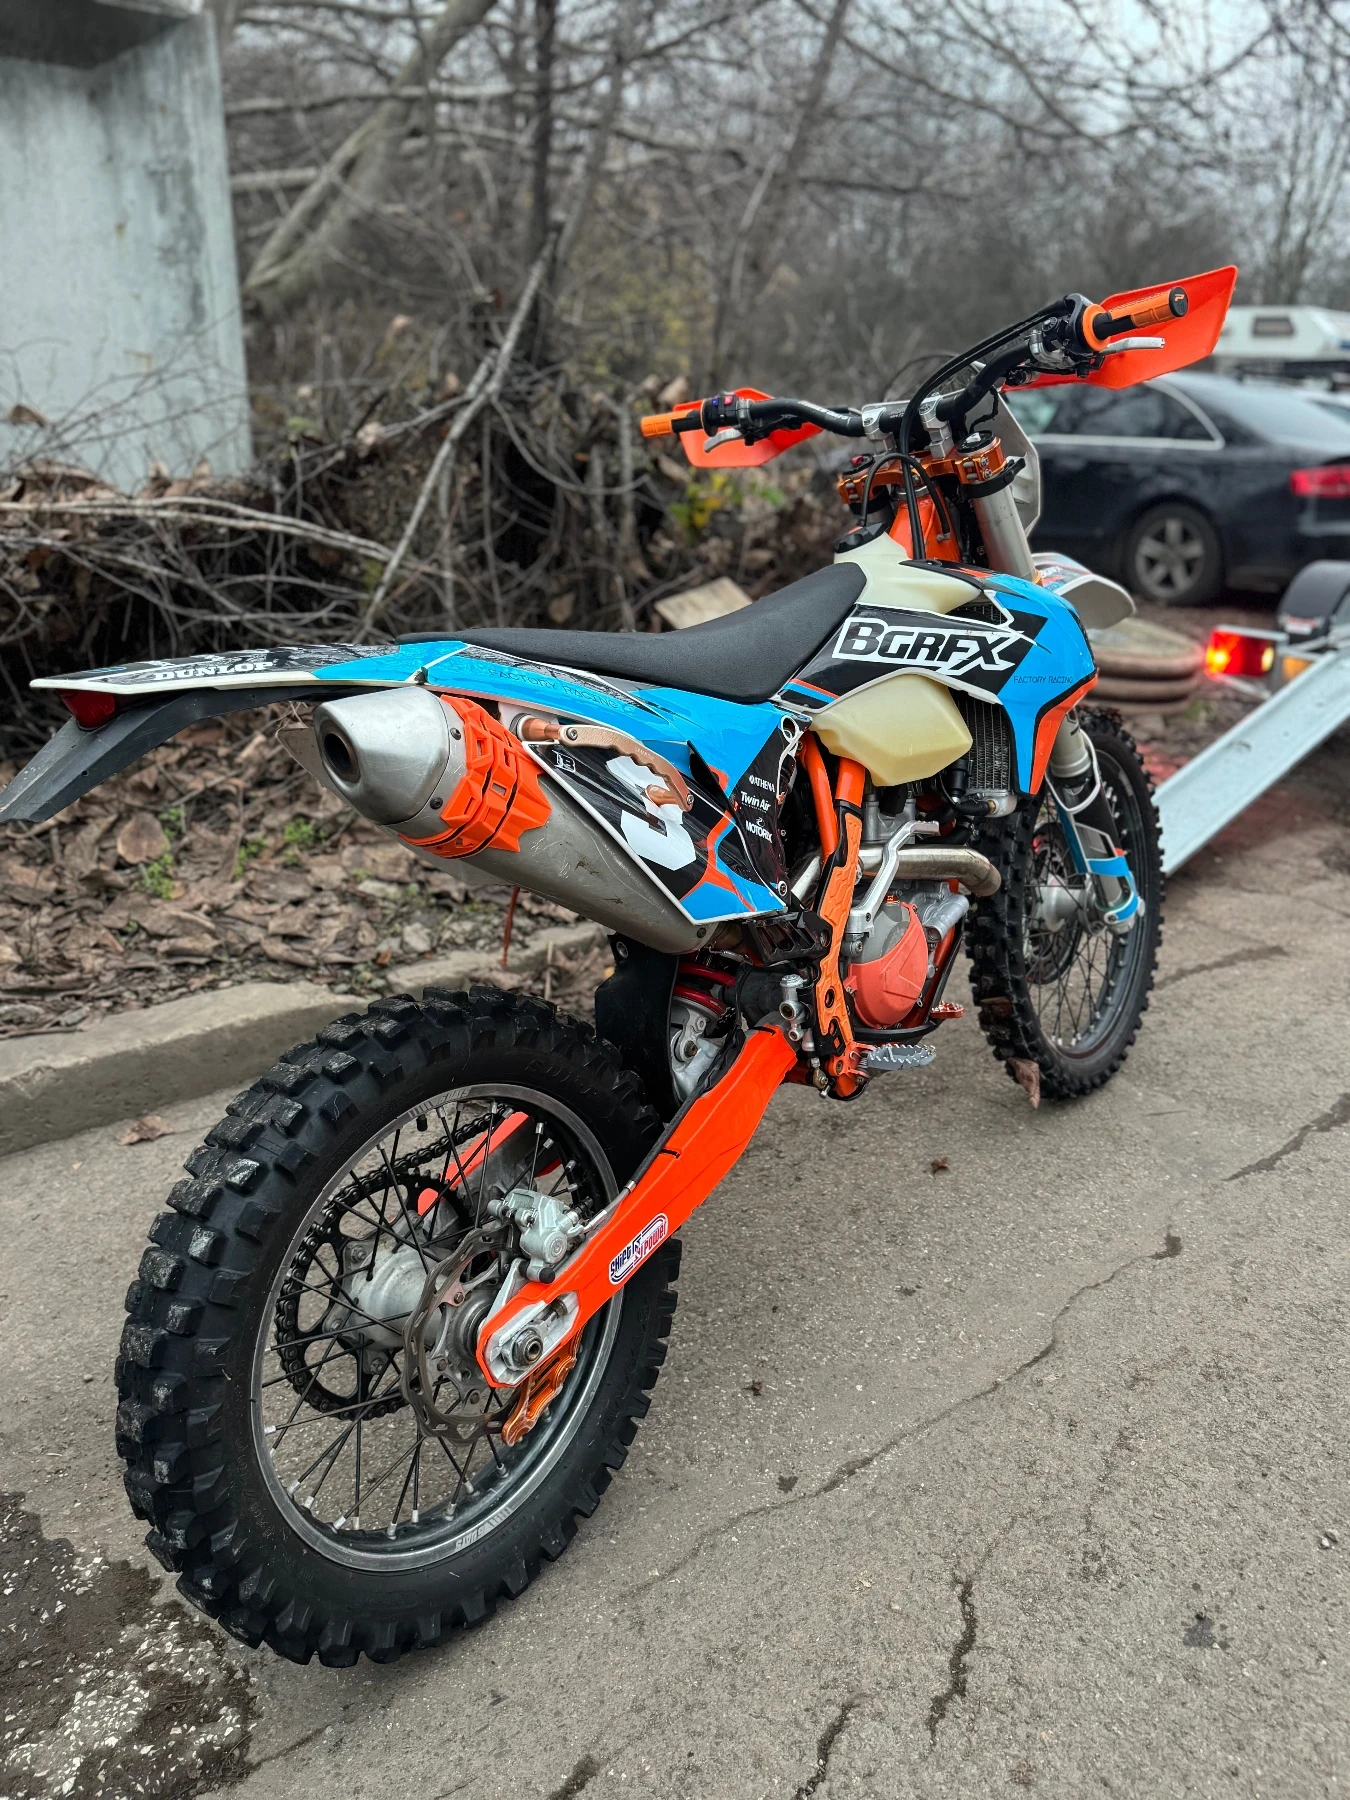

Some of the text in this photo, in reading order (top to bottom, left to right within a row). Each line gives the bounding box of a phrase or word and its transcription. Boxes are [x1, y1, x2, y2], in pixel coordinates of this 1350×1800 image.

[833, 617, 1014, 676] BGRFX
[153, 661, 274, 681] DUNLOP
[1013, 675, 1073, 684] FACTORY RACING
[489, 667, 618, 709] FACTORY RACING
[753, 777, 776, 793] ATHENA
[740, 791, 760, 807] Twin
[760, 799, 771, 811] Air
